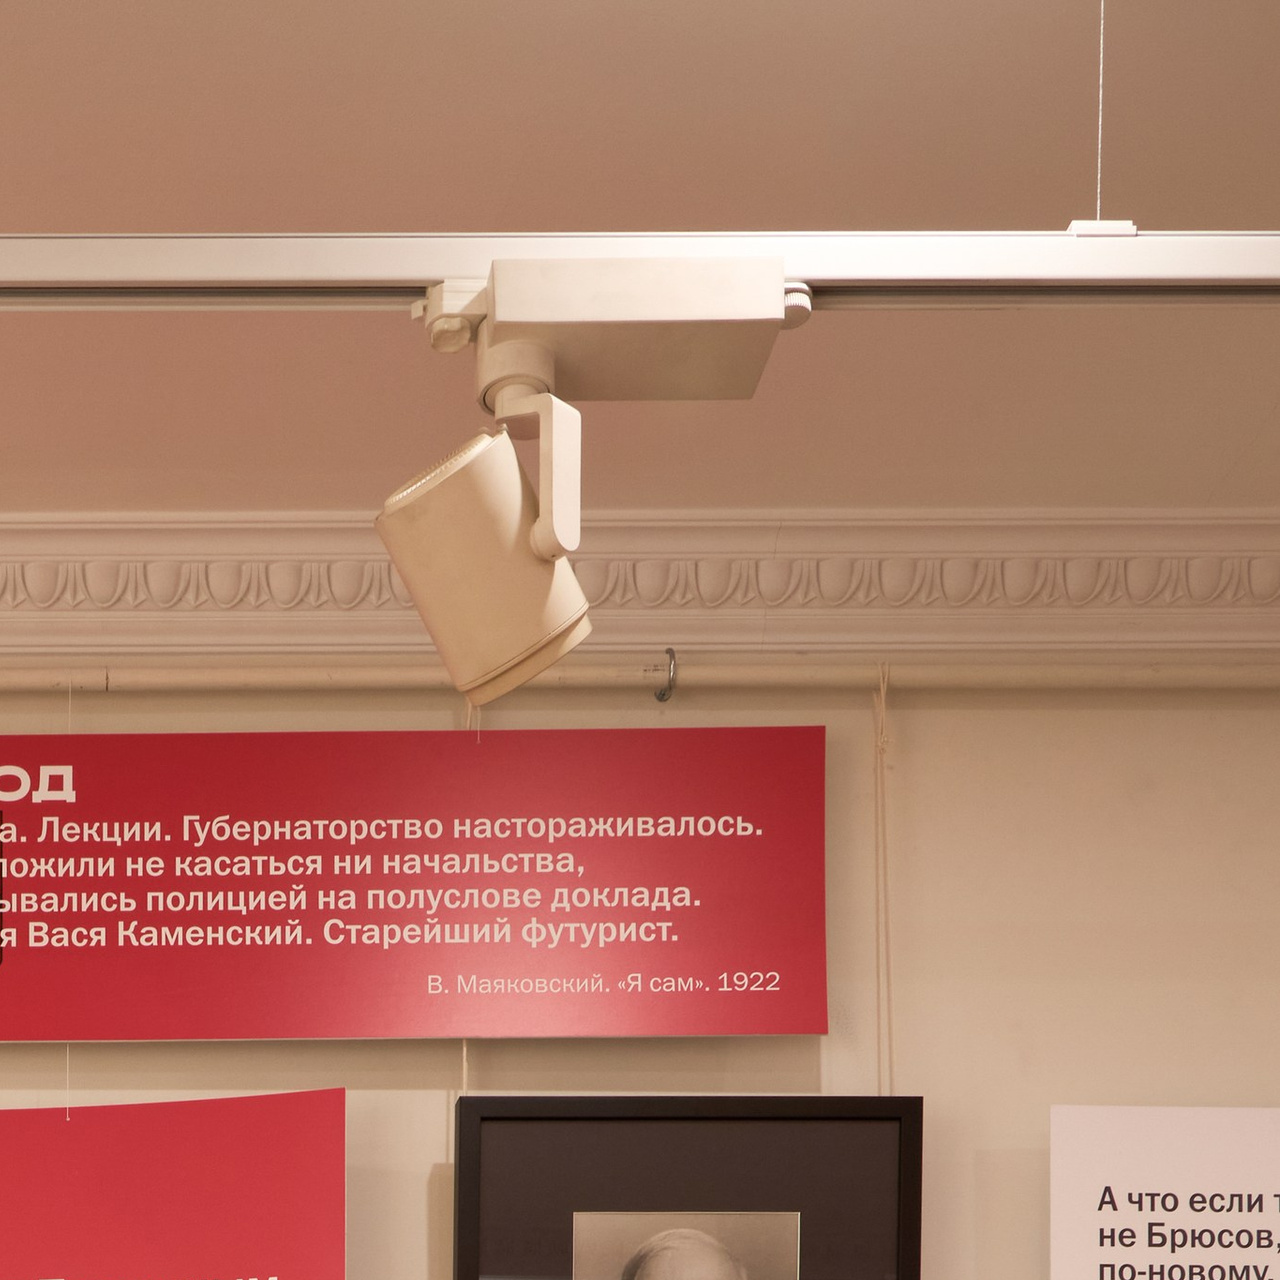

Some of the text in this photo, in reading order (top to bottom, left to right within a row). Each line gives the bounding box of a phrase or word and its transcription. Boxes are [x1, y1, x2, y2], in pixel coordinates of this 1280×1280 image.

[37, 816, 171, 847] Лекции.
[183, 815, 443, 847] Губернаторство
[453, 815, 763, 843] настораживалось.
[29, 921, 106, 947] Вася
[118, 919, 313, 946] Каменский.
[323, 916, 511, 950] Старейший
[521, 916, 678, 949] футурист.
[427, 971, 780, 994] В. Маяковский. «Я сам». 1922
[1097, 1185, 1263, 1213] А что если
[1099, 1227, 1137, 1248] не
